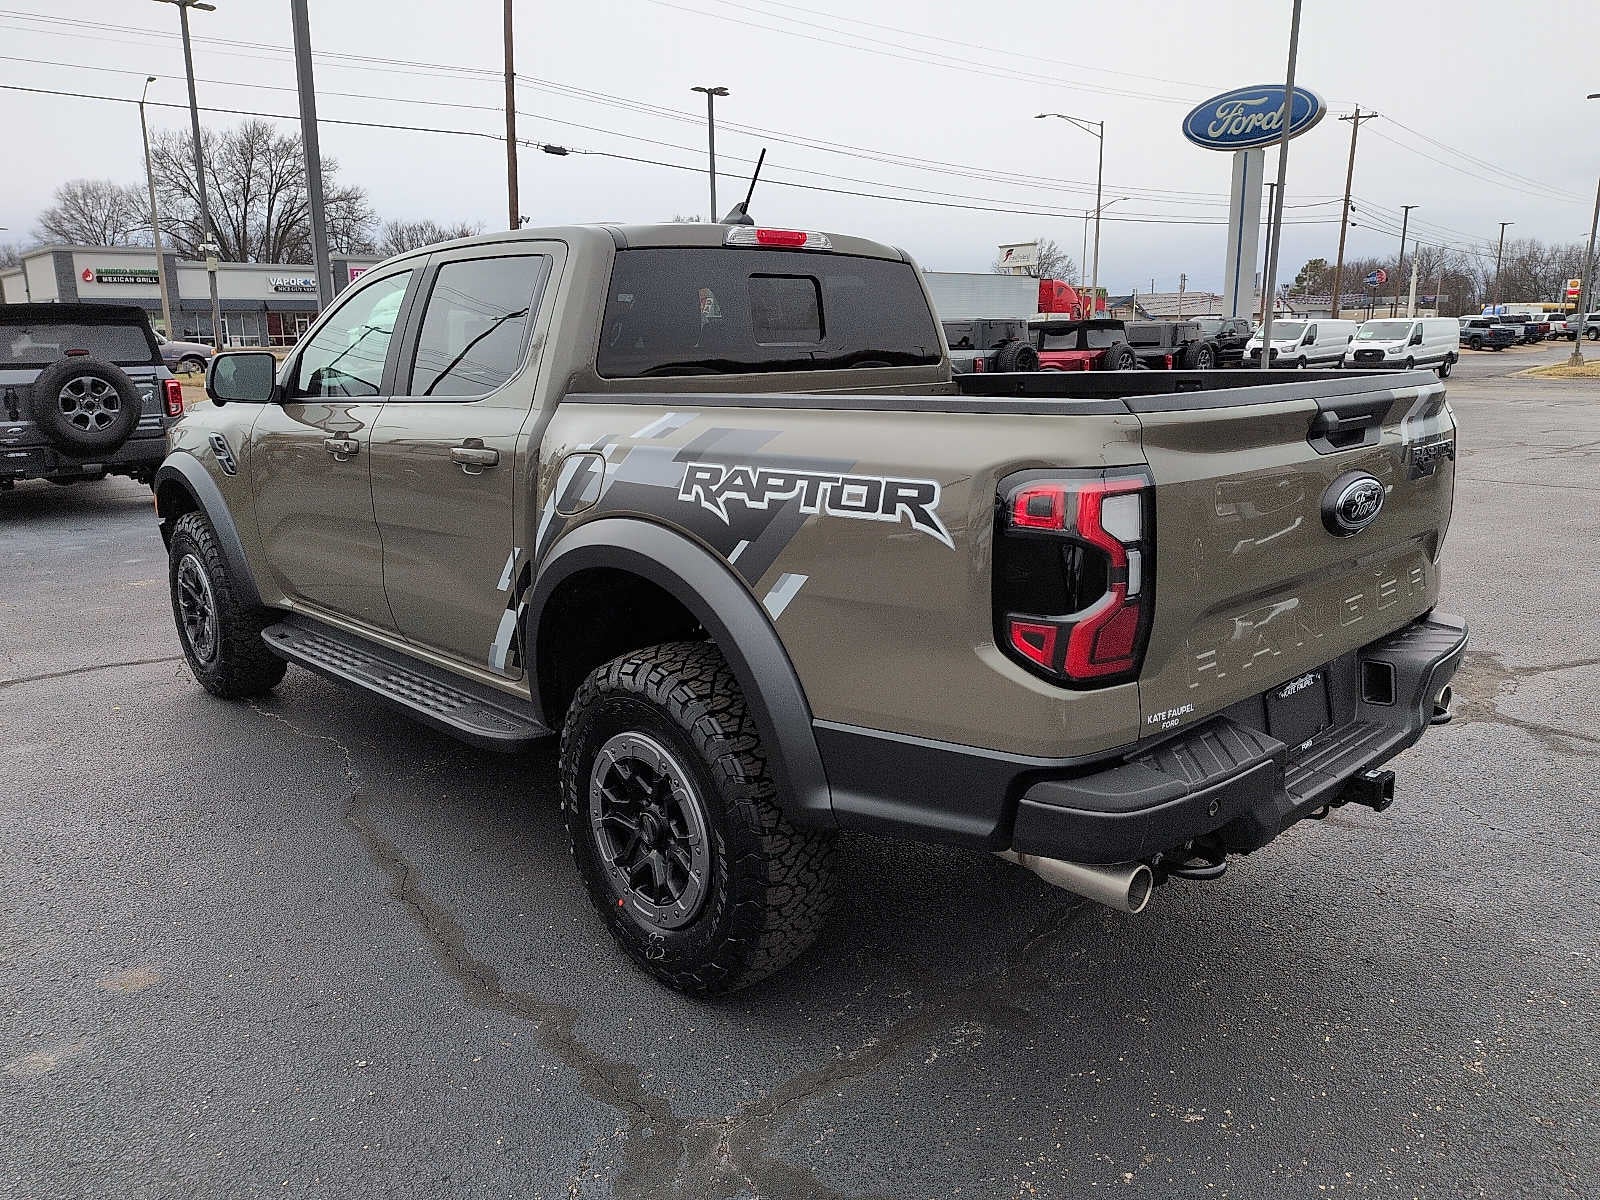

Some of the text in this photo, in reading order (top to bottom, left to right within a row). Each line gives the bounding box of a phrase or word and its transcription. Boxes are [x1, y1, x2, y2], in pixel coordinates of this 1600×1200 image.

[1207, 96, 1287, 138] Ford
[270, 278, 303, 286] VAPOR
[678, 461, 956, 551] RAPTOR
[1147, 703, 1195, 725] KATE FAUPEL
[1161, 718, 1180, 730] FORD
[1301, 739, 1313, 751] FORD
